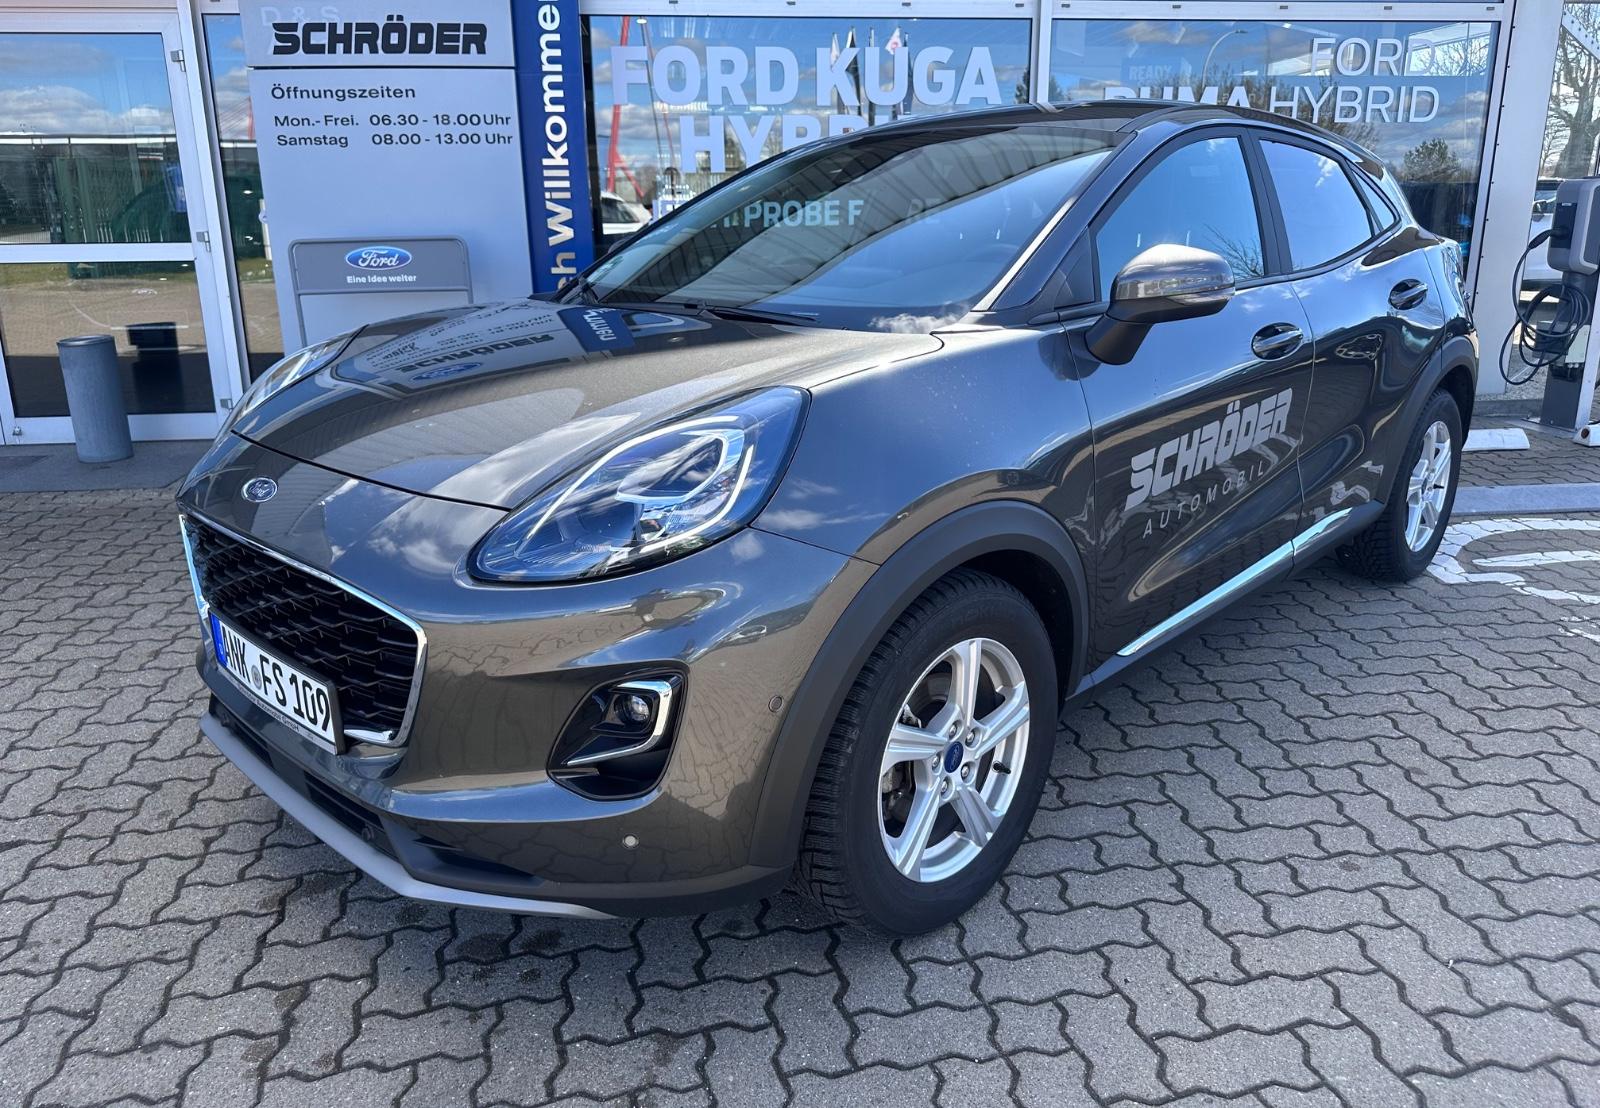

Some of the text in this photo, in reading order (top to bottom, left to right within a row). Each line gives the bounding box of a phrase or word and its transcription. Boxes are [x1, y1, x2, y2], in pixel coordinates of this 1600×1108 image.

[271, 14, 488, 55] SCHRÖDER
[1311, 37, 1435, 76] FORD
[271, 83, 416, 102] Öffnungszeiten
[610, 46, 1004, 106] FORD KUGA
[324, 114, 359, 126] Frei.
[369, 114, 419, 126] 06.30
[433, 113, 481, 126] 18.00
[483, 113, 512, 126] Uhr
[537, 0, 575, 246] Willkomme
[1269, 85, 1440, 123] HYBRID
[277, 134, 349, 148] Samstag
[371, 133, 421, 145] 08.00
[435, 133, 481, 145] 13.00
[485, 133, 513, 145] Uhr
[358, 249, 400, 267] Ford
[346, 274, 417, 283] Eine Idee weiter
[1123, 387, 1293, 512] SCHRÖDER
[221, 625, 331, 732] ANK FS 109
